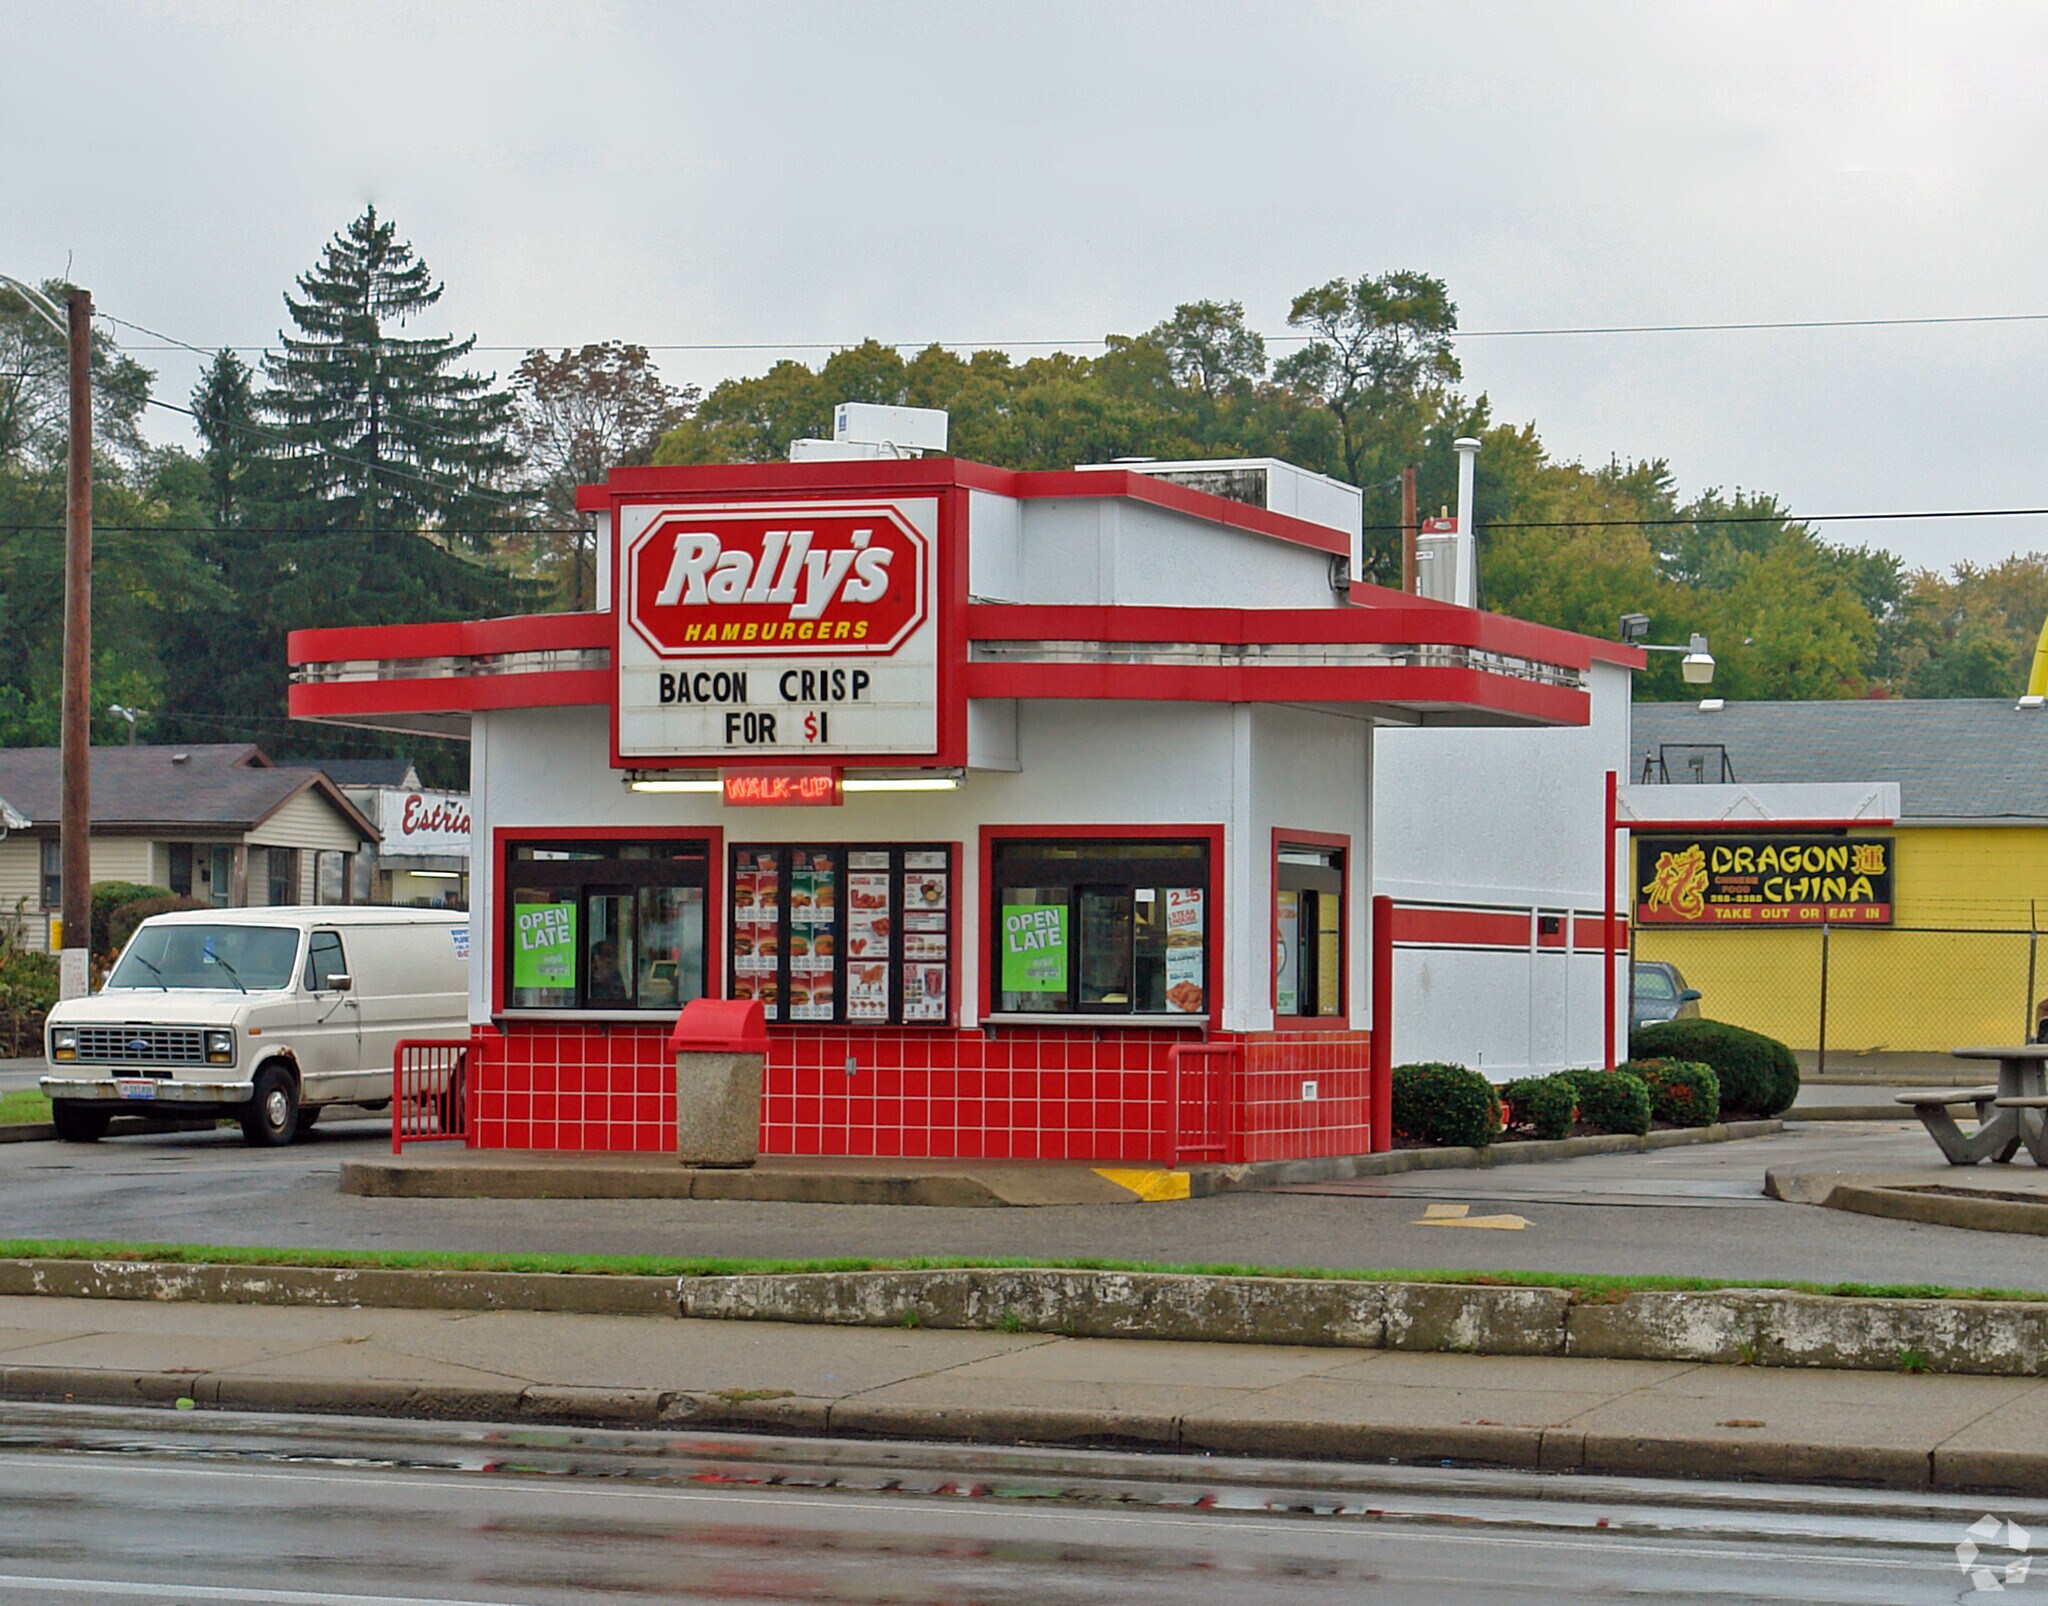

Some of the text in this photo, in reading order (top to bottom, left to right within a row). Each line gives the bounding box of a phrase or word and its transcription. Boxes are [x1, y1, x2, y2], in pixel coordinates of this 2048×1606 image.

[655, 529, 894, 619] Rally's
[684, 621, 869, 641] HAMBURGERS
[659, 669, 870, 703] BACON CRISP
[725, 712, 777, 744] FOR
[725, 777, 833, 799] WALK-UP
[1711, 844, 1849, 874] DRAGON
[1170, 891, 1181, 906] 2
[1721, 885, 1751, 894] FOOD
[1763, 876, 1874, 903] CHINA
[518, 907, 569, 931] OPEN
[1006, 908, 1060, 932] OPEN
[1714, 907, 1880, 919] TAKE OUT OR EAT IN
[521, 924, 572, 951] LATE
[1009, 926, 1063, 953] LATE
